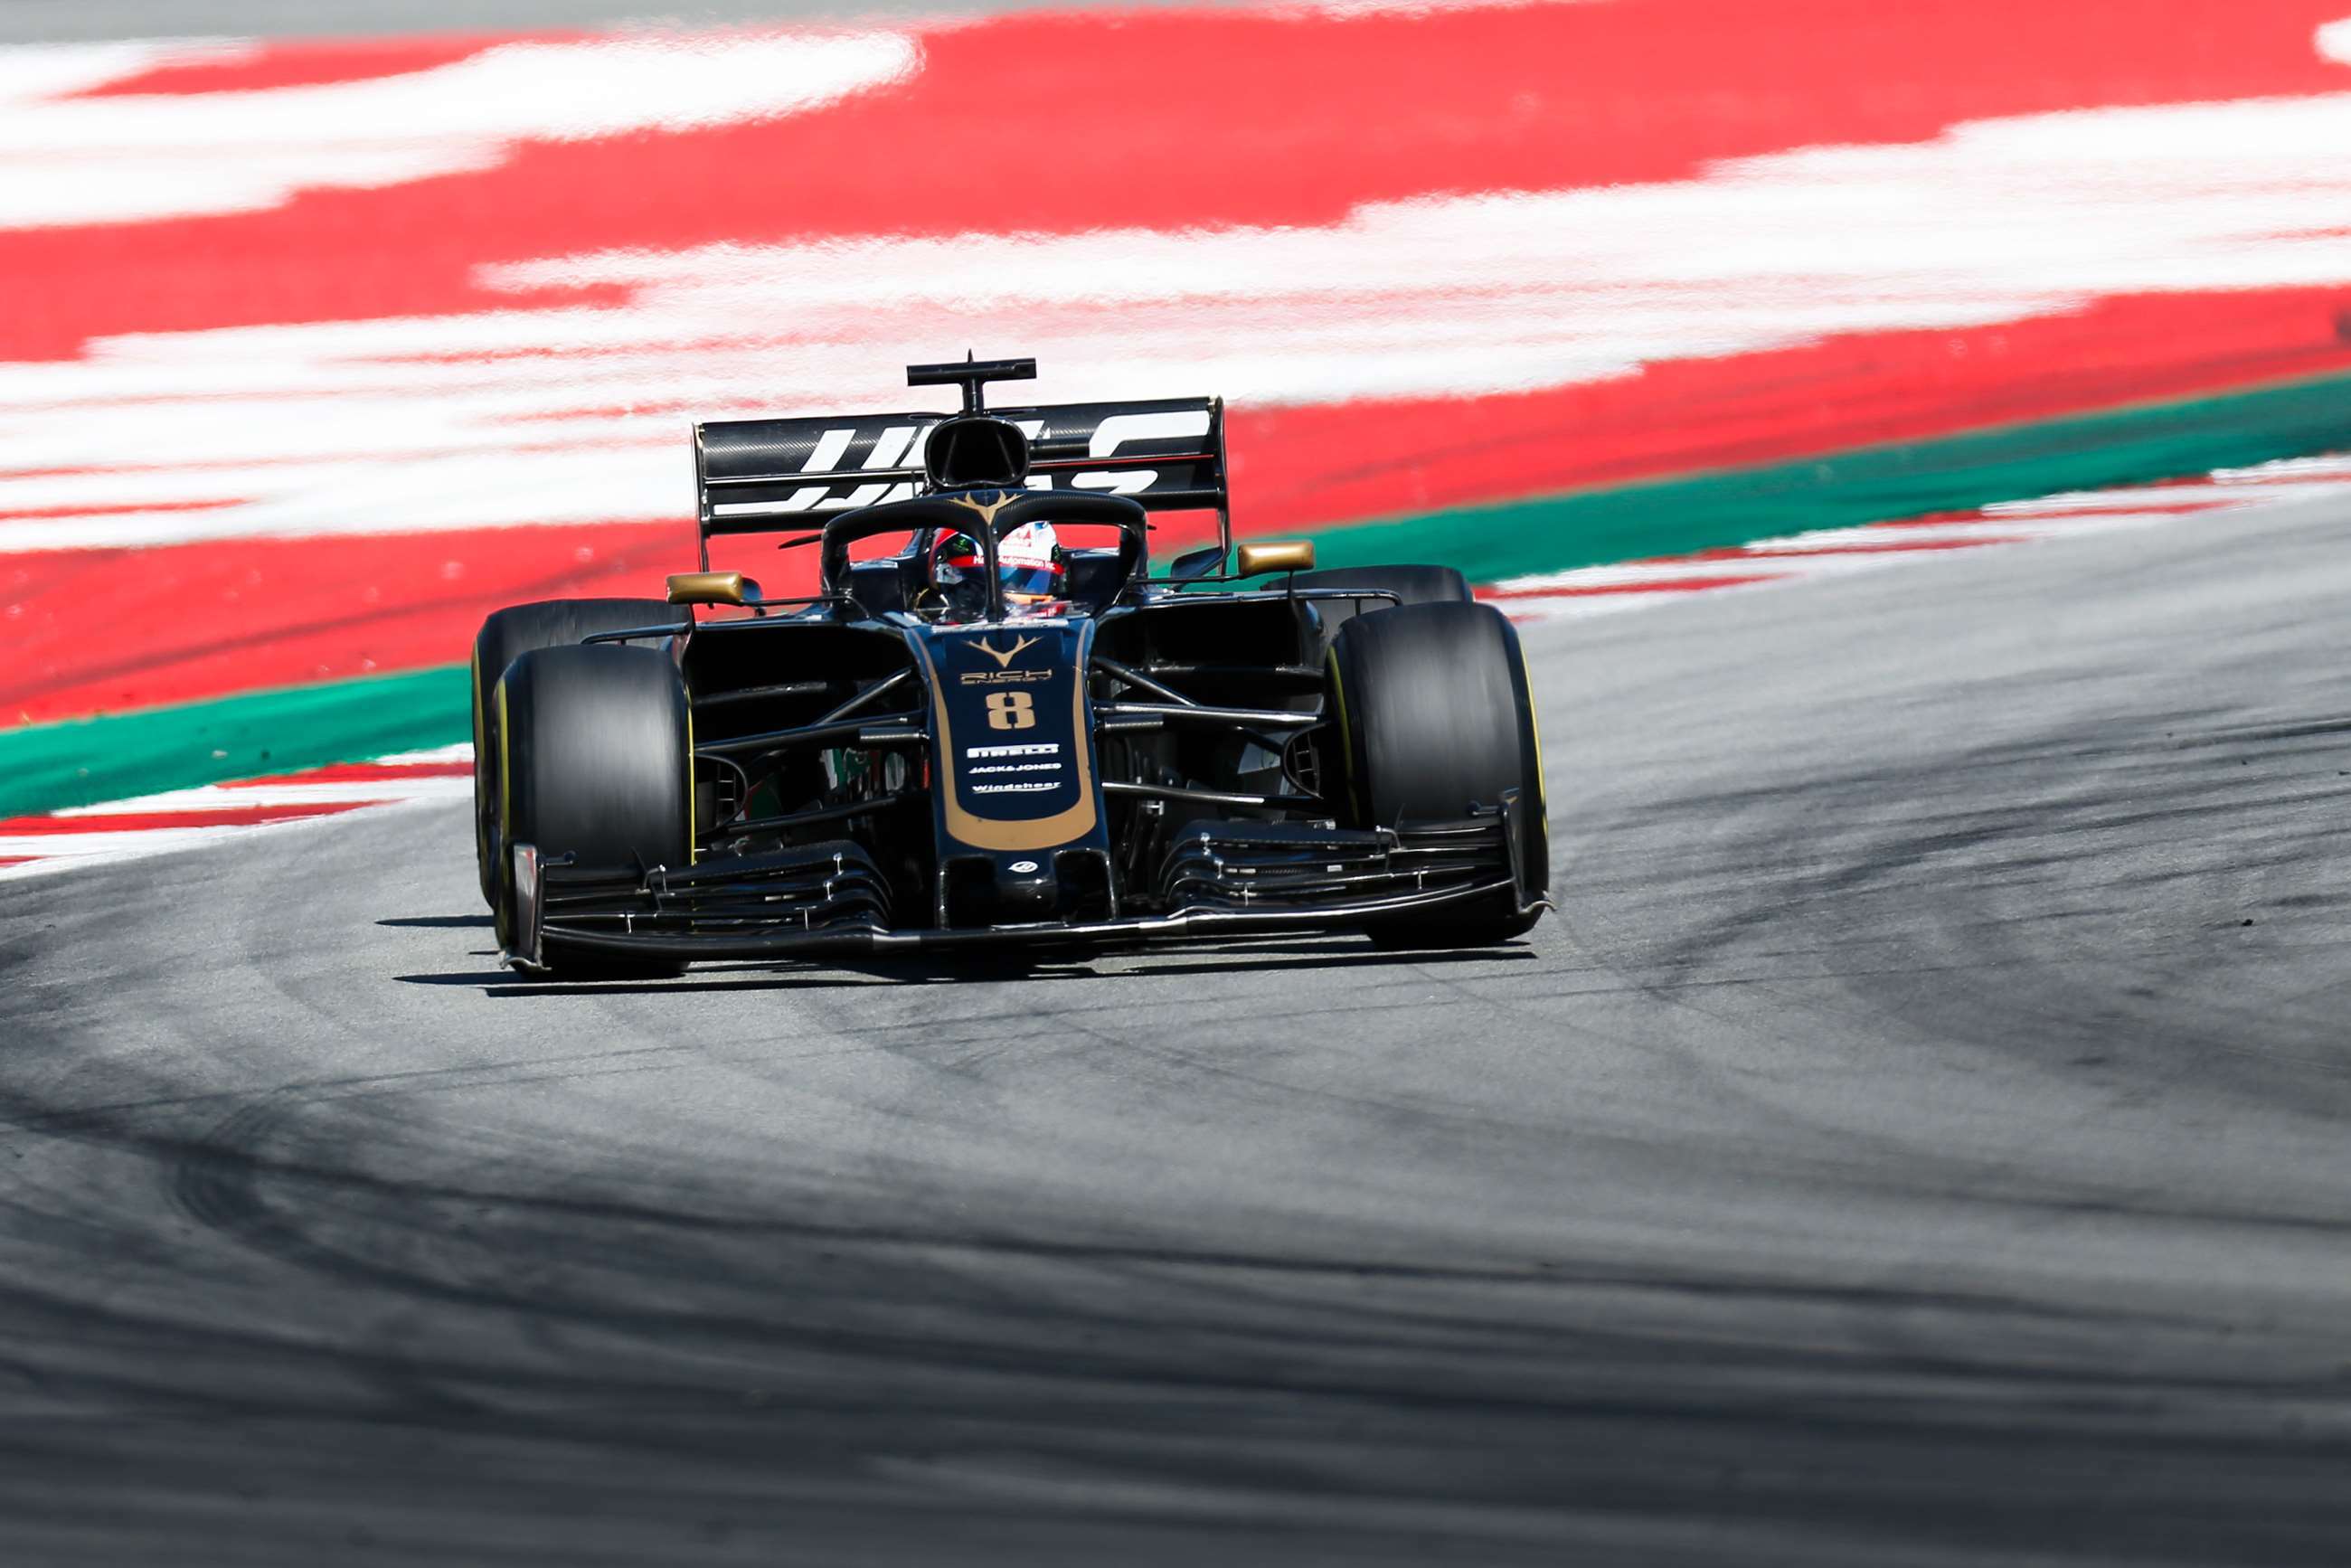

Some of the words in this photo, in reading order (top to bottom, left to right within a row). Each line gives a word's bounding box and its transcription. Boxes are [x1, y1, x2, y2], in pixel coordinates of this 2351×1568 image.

[714, 411, 1210, 515] HS
[961, 669, 1053, 681] RICH
[986, 691, 1036, 730] 8
[967, 743, 1060, 759] PIRELLI
